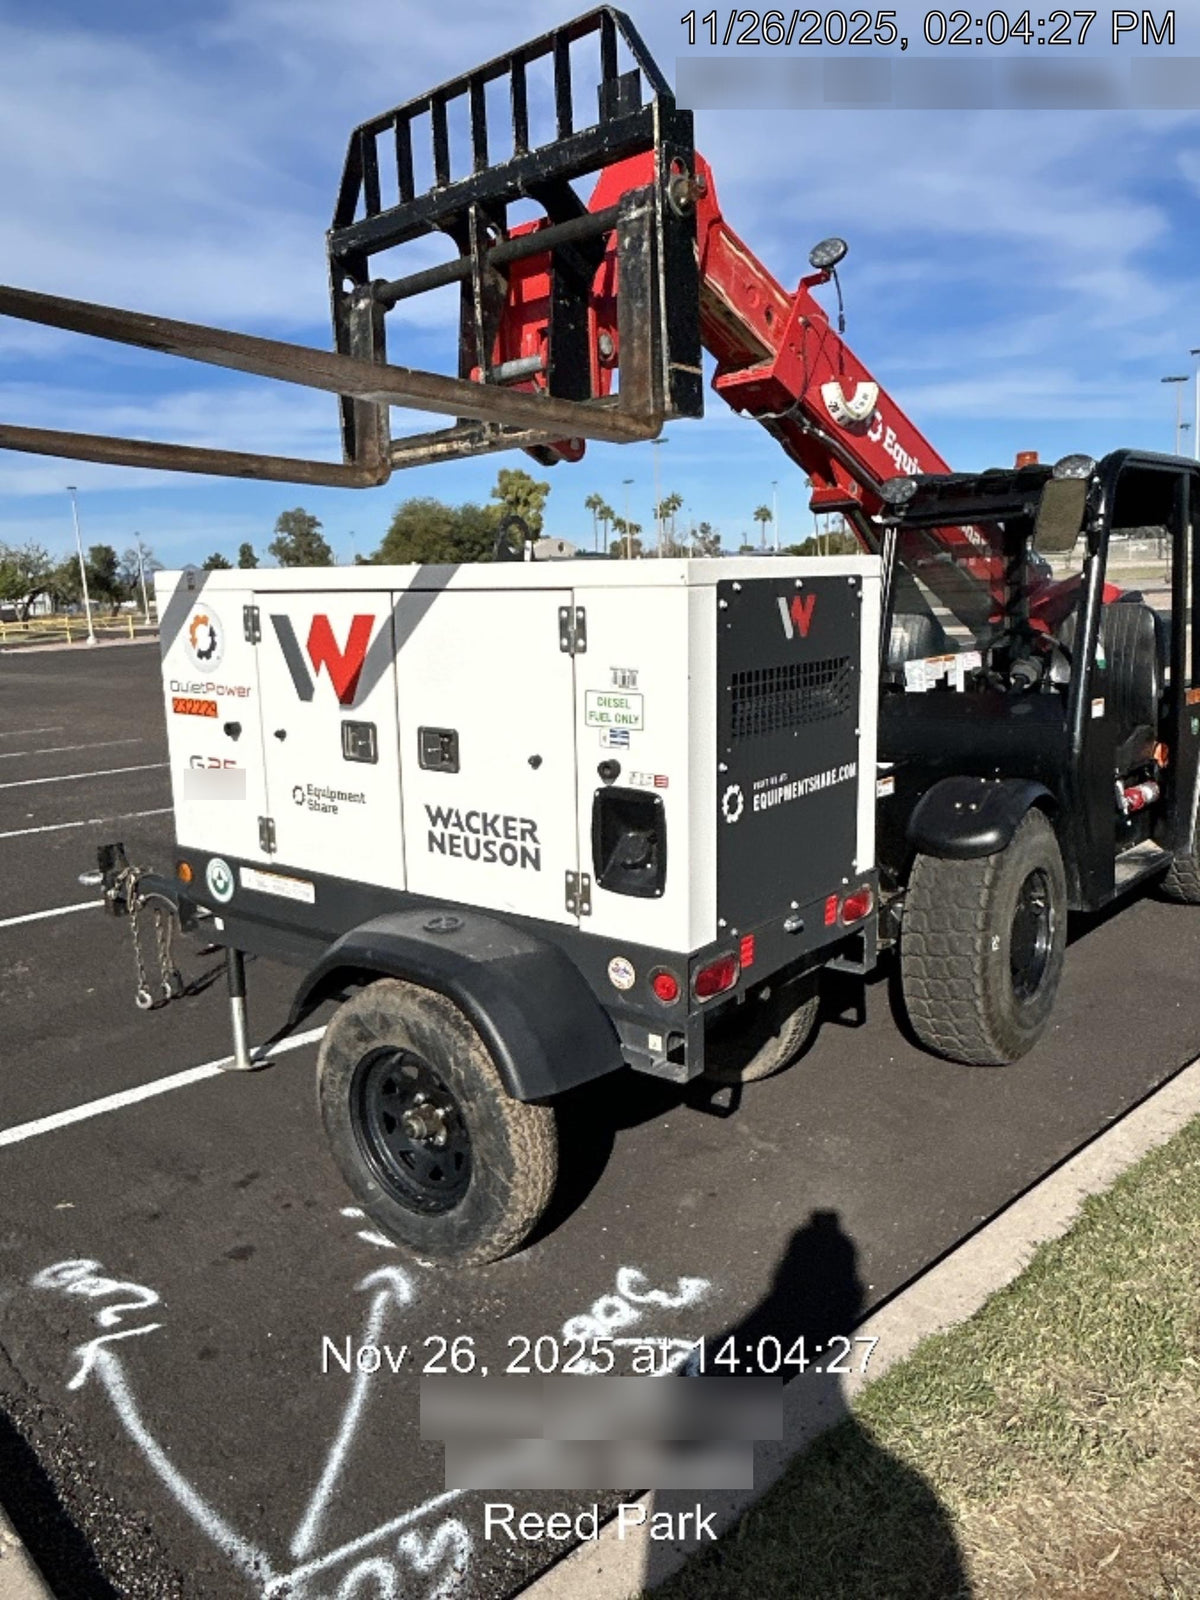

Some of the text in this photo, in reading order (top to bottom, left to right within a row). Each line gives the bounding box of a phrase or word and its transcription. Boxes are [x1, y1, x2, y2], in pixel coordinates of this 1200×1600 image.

[883, 426, 924, 475] Equi
[588, 711, 639, 725] FUEL ONLY
[597, 696, 631, 710] DIESEL
[307, 784, 366, 804] Equipment
[753, 762, 857, 812] EQUIPMENTSHARE.COM
[307, 799, 339, 814] Share
[424, 804, 541, 845] WACKER
[427, 830, 541, 871] NEUSON
